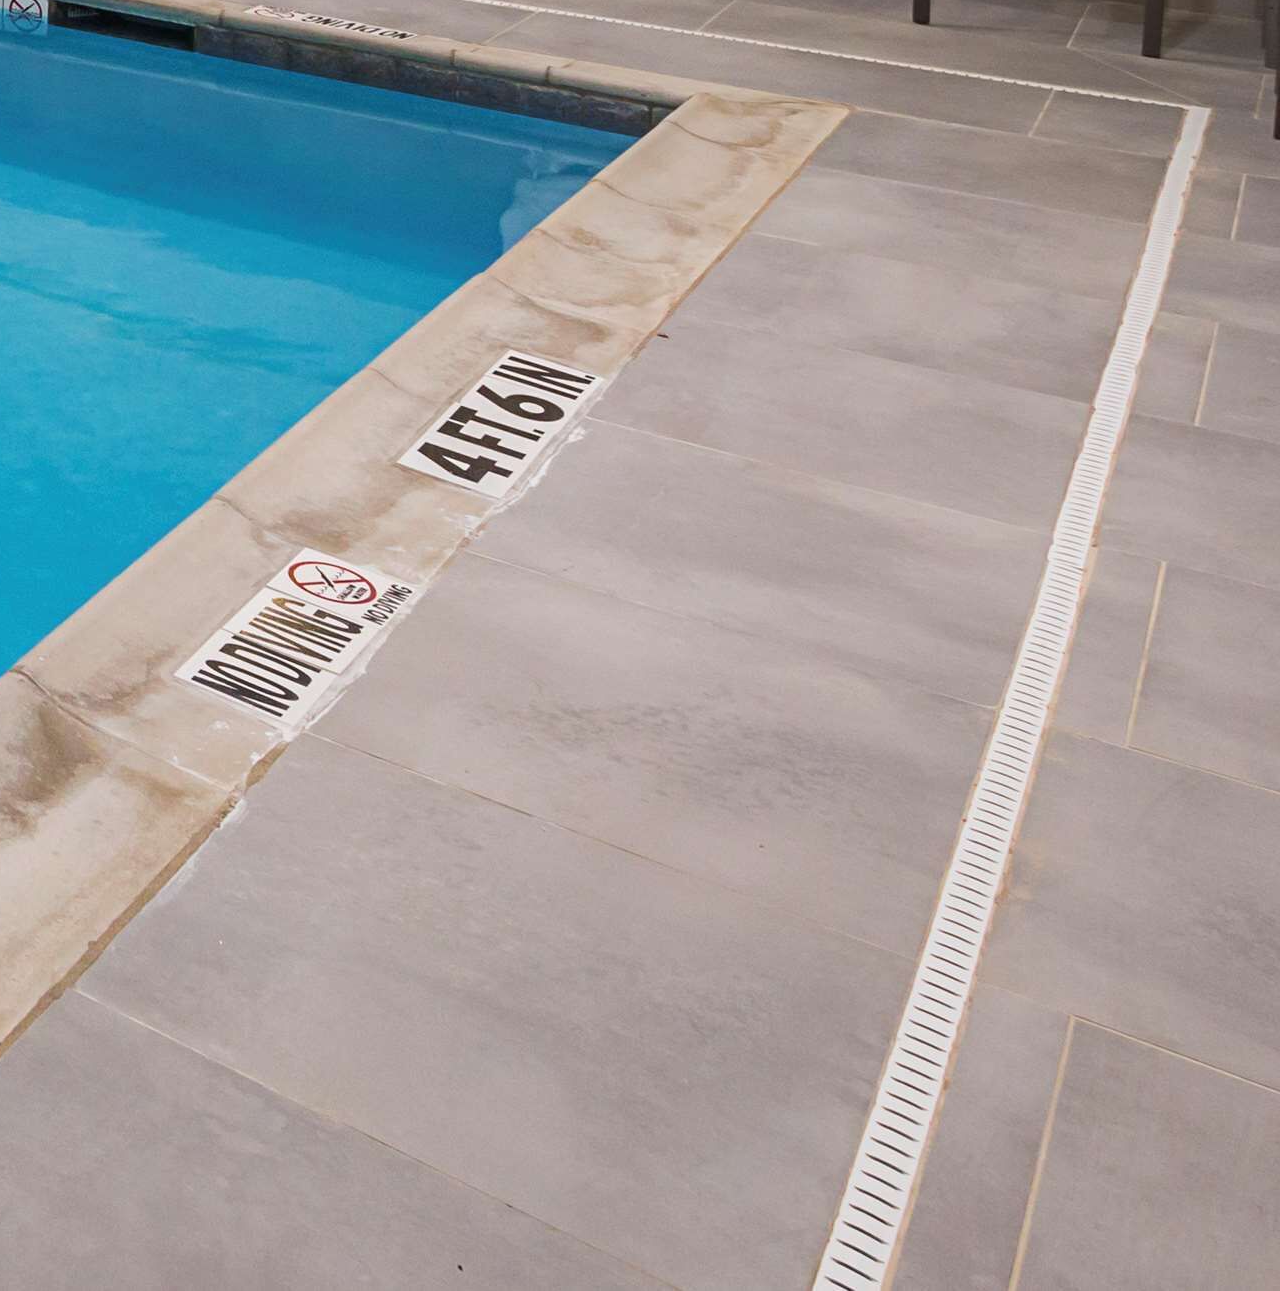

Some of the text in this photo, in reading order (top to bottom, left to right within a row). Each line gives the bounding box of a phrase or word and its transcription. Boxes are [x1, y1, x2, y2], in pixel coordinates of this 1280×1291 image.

[416, 355, 597, 485] 4 FT. 6 IN.
[191, 595, 364, 718] NO DIVING
[361, 583, 413, 626] NO DIVING
